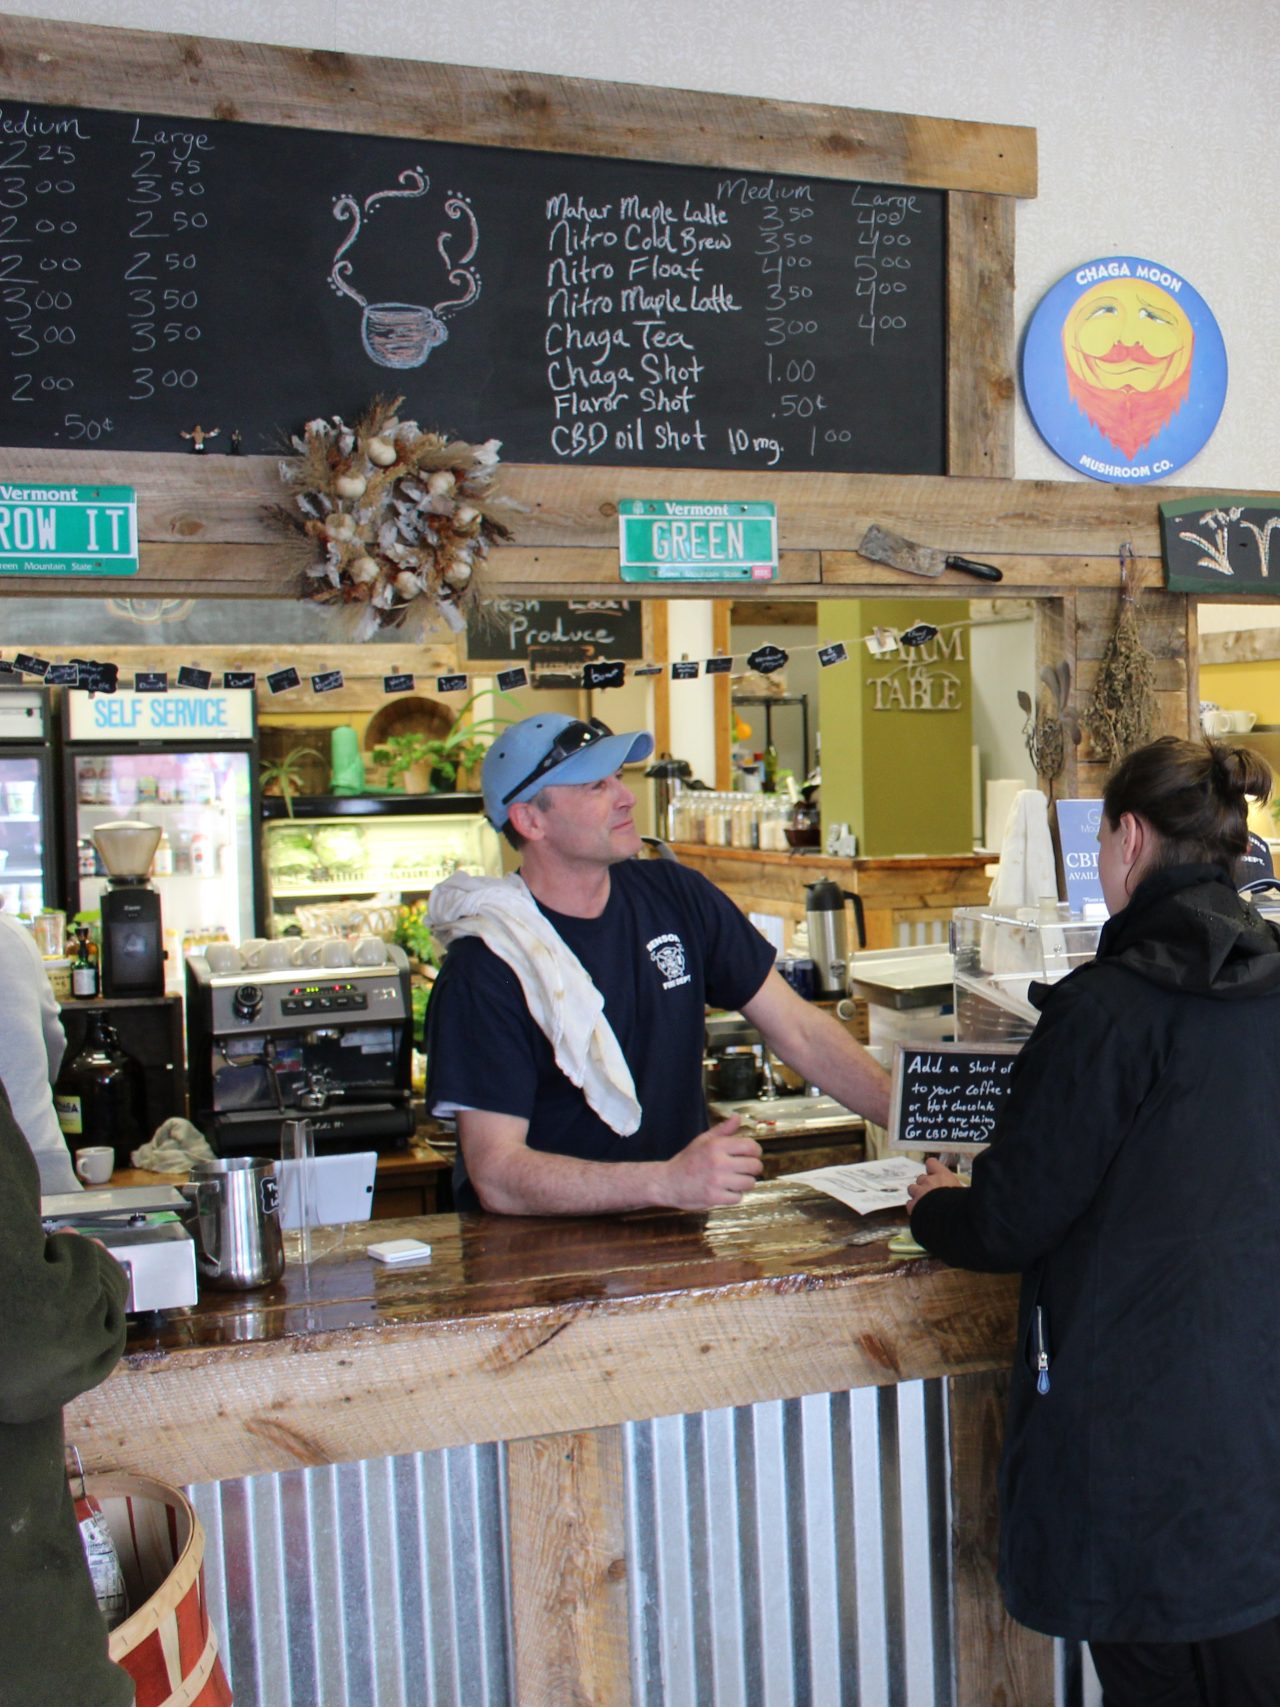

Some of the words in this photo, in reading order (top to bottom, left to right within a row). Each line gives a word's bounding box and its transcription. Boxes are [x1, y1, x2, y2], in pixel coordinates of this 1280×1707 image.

[0, 110, 91, 139] edium
[131, 119, 216, 160] Large
[620, 198, 674, 231] Maple
[683, 199, 729, 226] Latte
[717, 178, 814, 203] Medium
[851, 185, 922, 220] Large
[549, 221, 618, 256] Nitro
[624, 225, 672, 252] Cold
[681, 229, 732, 255] Brew
[547, 257, 614, 288] Nitro
[628, 256, 704, 282] Float
[1076, 263, 1131, 286] CHAGA
[1136, 265, 1182, 293] MOON
[547, 287, 613, 318] Nitro
[621, 287, 687, 317] Maple
[691, 283, 742, 312] Latte
[545, 324, 630, 365] Chaga
[633, 320, 695, 351] Tea
[548, 355, 634, 397] Chaga
[642, 353, 705, 386] Shot
[555, 391, 629, 418] Flavor
[640, 386, 696, 413] Shot
[551, 422, 608, 456] CBD
[615, 417, 643, 450] oil
[1079, 455, 1150, 478] MUSHROOM
[1153, 460, 1174, 474] CO.
[0, 486, 78, 501] Vermont
[664, 502, 729, 516] Vermont
[86, 509, 124, 552] IT
[652, 521, 744, 561] GREEN
[24, 562, 66, 571] Mountain
[71, 562, 93, 571] State
[510, 617, 615, 650] Produce
[866, 678, 962, 710] TABLE
[95, 699, 142, 728] SELF
[150, 698, 227, 728] SERVICE
[908, 1056, 943, 1074] Add
[950, 1064, 959, 1074] a
[909, 1103, 921, 1112] or
[911, 1083, 928, 1094] to
[928, 1086, 961, 1100] your
[908, 1114, 944, 1124] about
[926, 1129, 948, 1139] CBD
